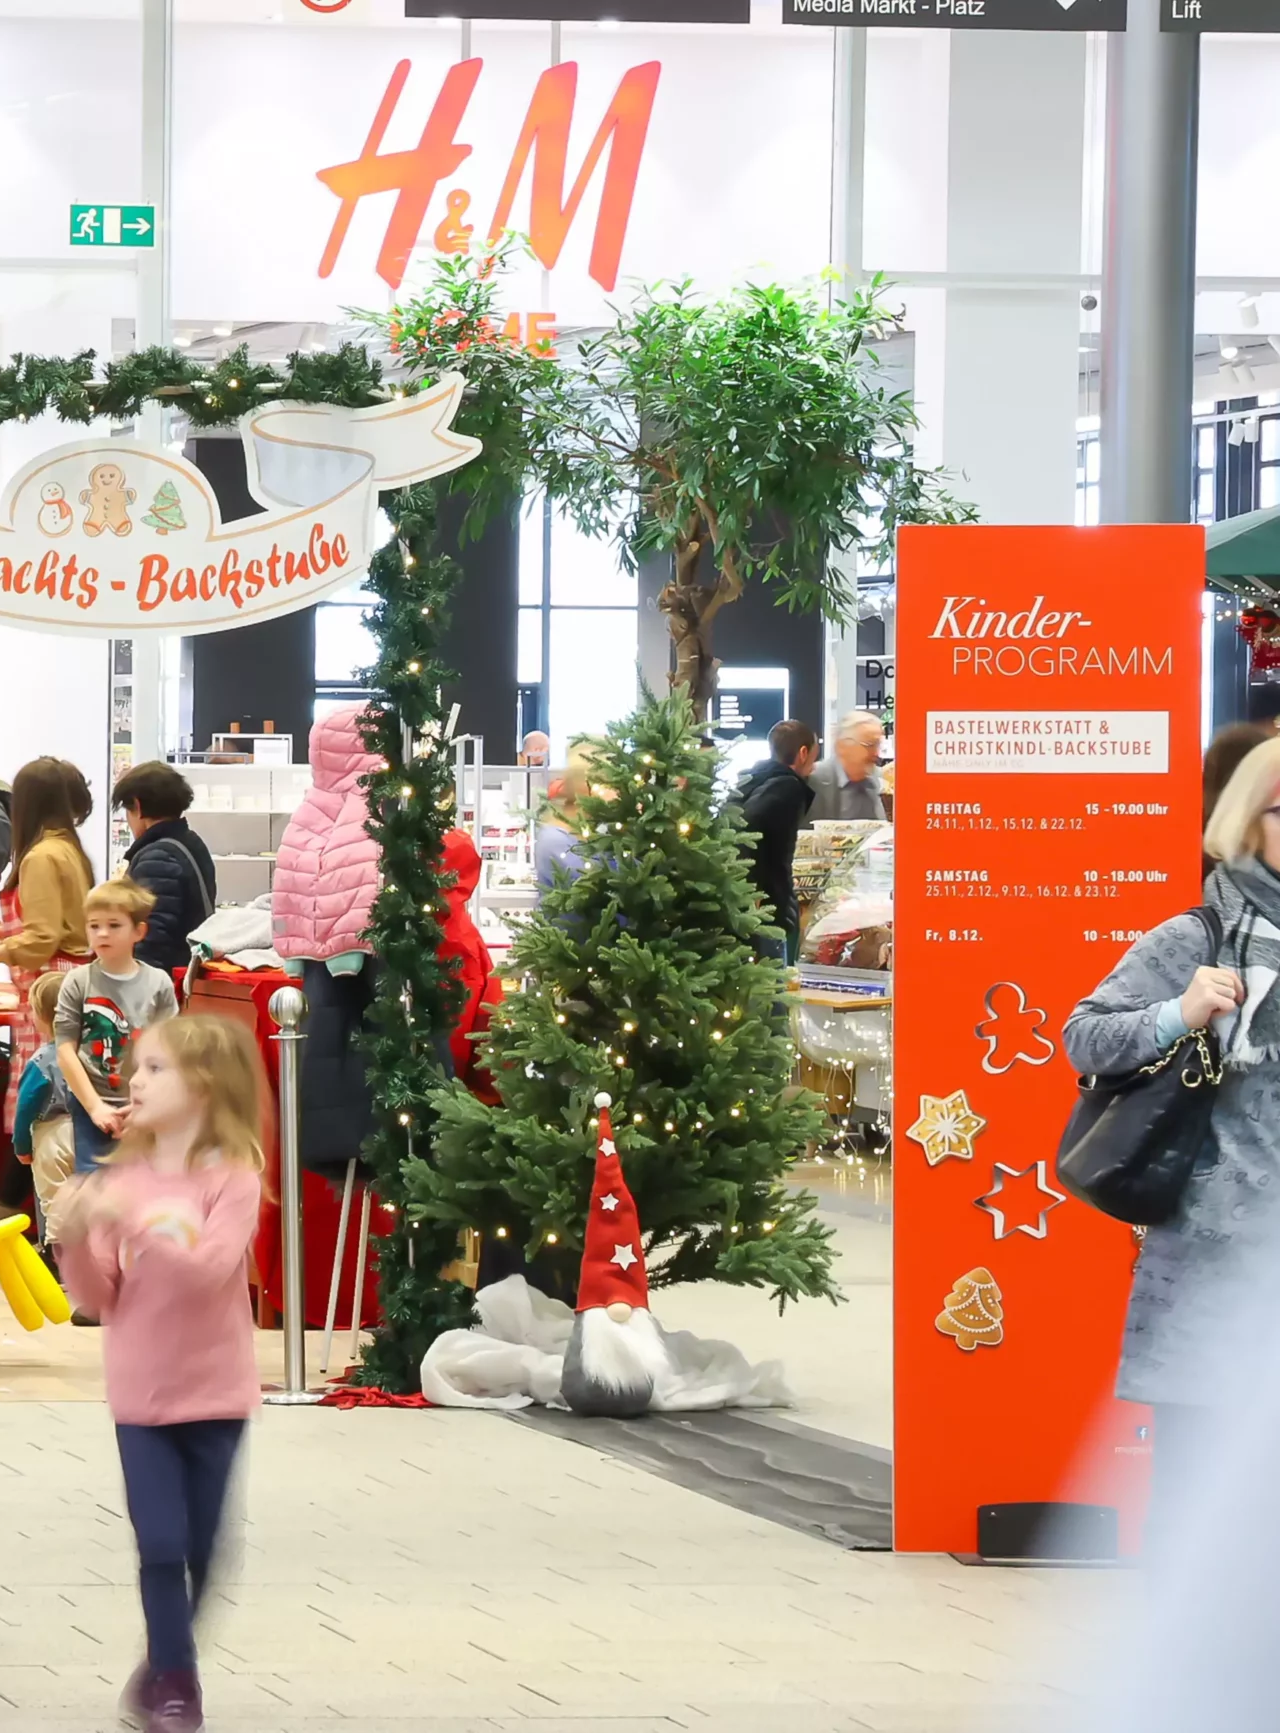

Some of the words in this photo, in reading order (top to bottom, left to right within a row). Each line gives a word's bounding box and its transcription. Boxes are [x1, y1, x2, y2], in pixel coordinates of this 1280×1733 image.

[793, 0, 852, 13] Media
[861, 0, 917, 15] Markt
[936, 0, 986, 17] Platz
[1172, 1, 1202, 19] Lift
[317, 58, 662, 292] H&M
[136, 522, 350, 612] Backstube
[927, 595, 1092, 639] Kinder-
[953, 646, 1173, 676] PROGRAMM
[934, 720, 1092, 735] BASTELWERKSTATT
[1099, 720, 1110, 735] &
[933, 740, 1152, 756] CHRISTKINDL-BACKSTUBE
[926, 803, 982, 815] FREITAG
[1085, 803, 1099, 815] 15
[1112, 803, 1144, 815] 19.00
[1146, 803, 1169, 815] Uhr
[926, 818, 965, 831] 24.11.,
[969, 818, 1000, 831] 1.12.,
[1003, 818, 1037, 830] 15.12.
[1039, 818, 1048, 830] &
[1050, 818, 1086, 830] 22.12.
[925, 870, 989, 882] SAMSTAG
[1084, 870, 1098, 882] 10
[1111, 870, 1144, 882] 18.00
[1146, 870, 1169, 882] Uhr
[926, 885, 964, 898] 25.11.,
[967, 885, 999, 898] 2.12.,
[1001, 885, 1033, 898] 9.12.,
[1037, 885, 1072, 897] 16.12.
[1074, 885, 1082, 897] &
[1084, 885, 1120, 897] 23.12.
[925, 930, 943, 943] Fr,
[949, 930, 983, 942] 8.12.
[1083, 930, 1098, 942] 10
